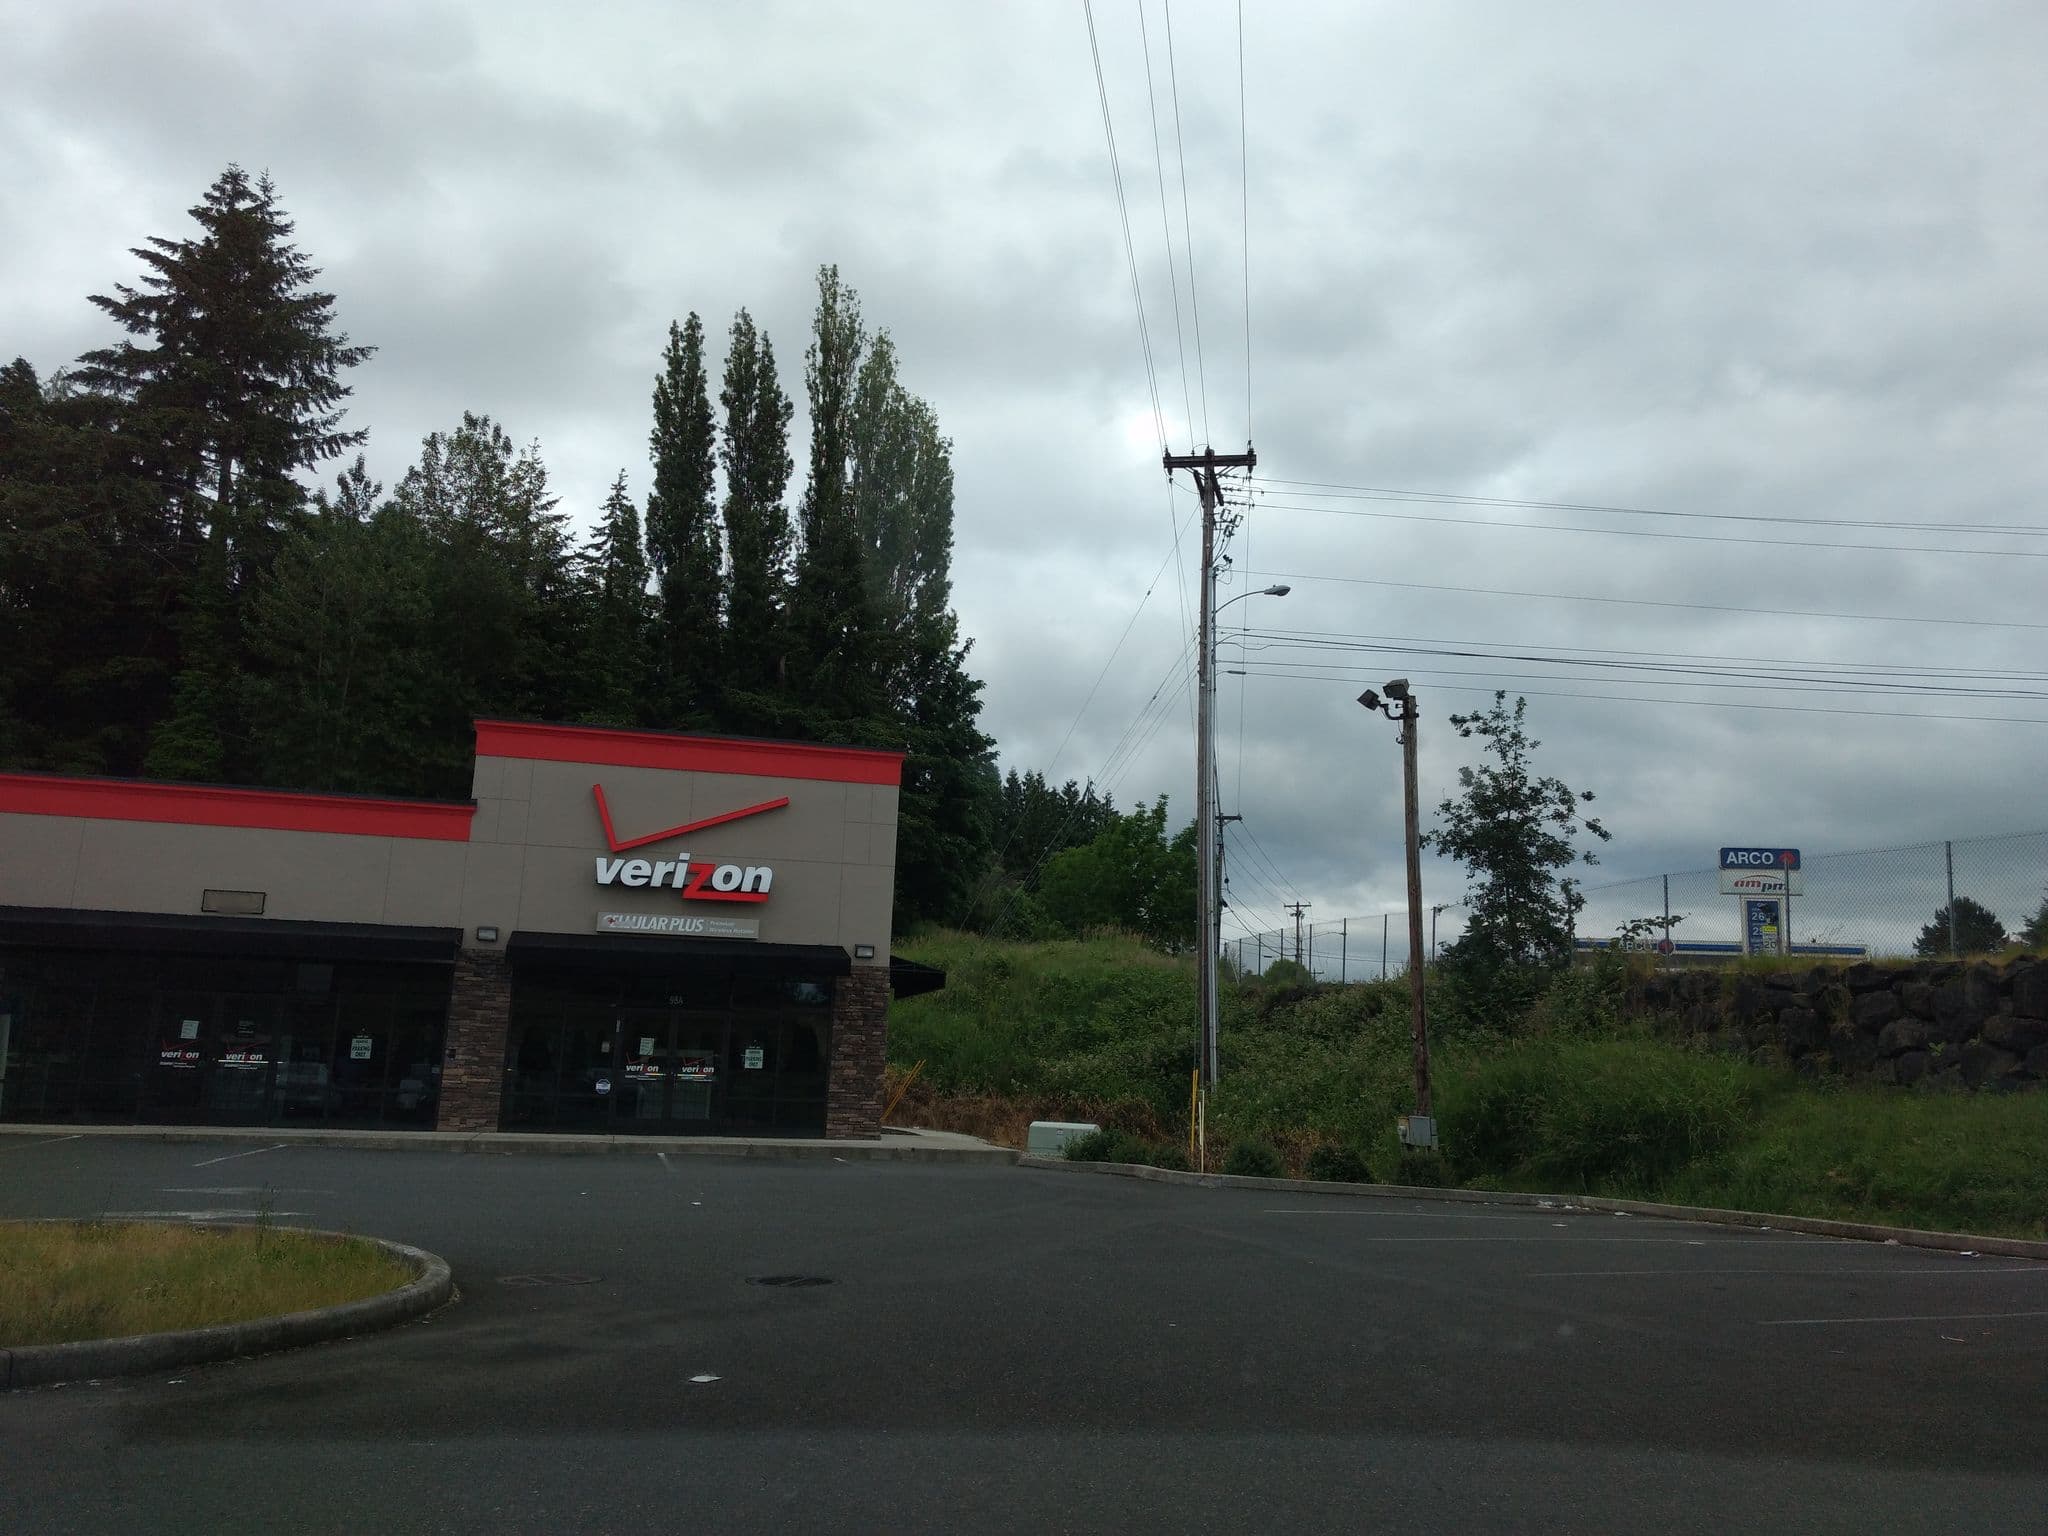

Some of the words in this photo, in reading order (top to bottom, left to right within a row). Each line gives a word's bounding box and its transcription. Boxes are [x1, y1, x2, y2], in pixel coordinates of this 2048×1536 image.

[1726, 851, 1774, 865] ARCO
[596, 852, 774, 903] verizon
[669, 917, 705, 932] PLUS
